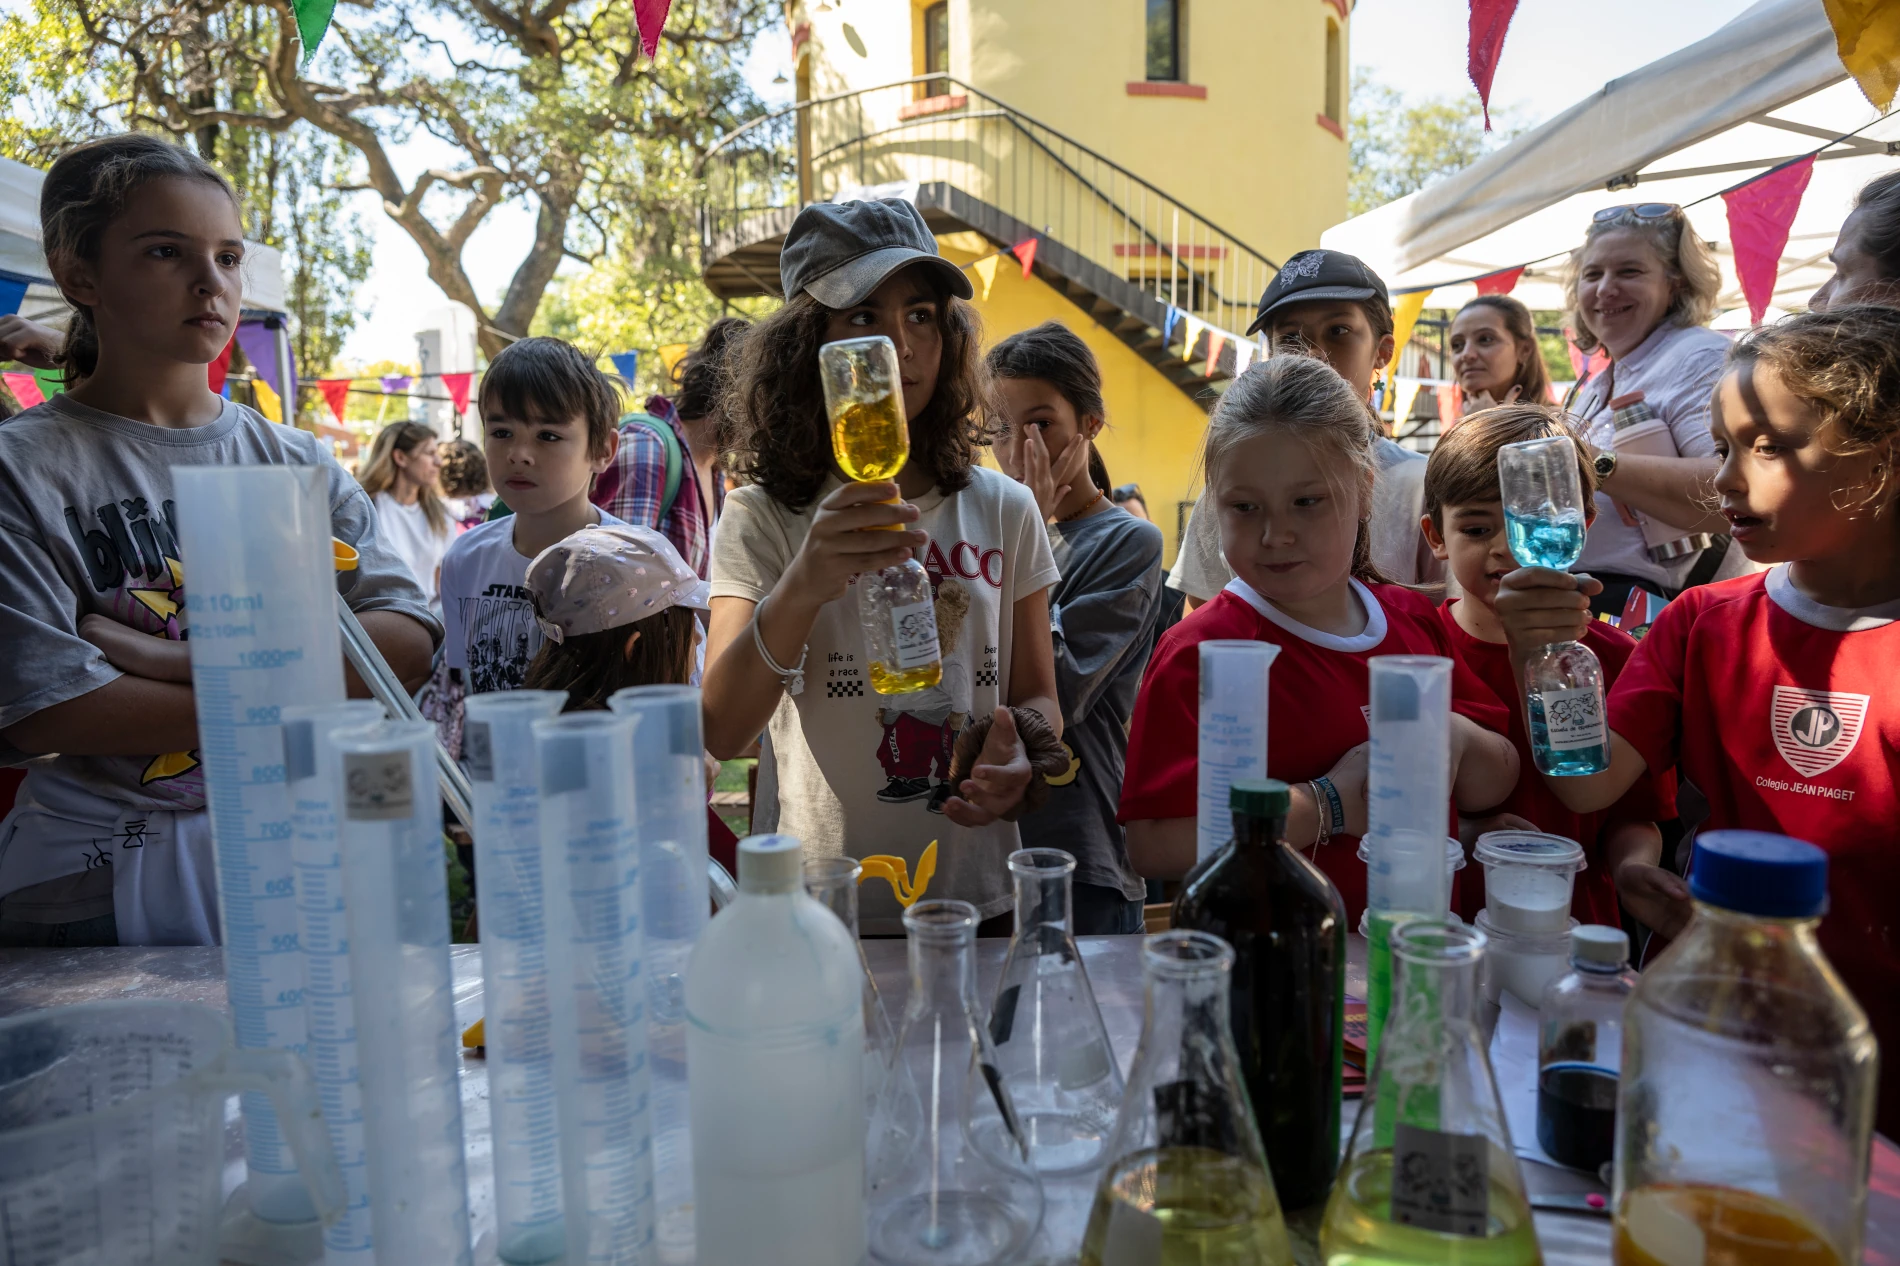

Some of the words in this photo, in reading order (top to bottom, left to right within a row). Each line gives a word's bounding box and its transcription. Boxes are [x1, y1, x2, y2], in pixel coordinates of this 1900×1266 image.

[828, 652, 843, 662] life
[1756, 776, 1789, 791] Colegio
[1790, 782, 1817, 796] JEAN
[1817, 786, 1855, 801] PIAGET
